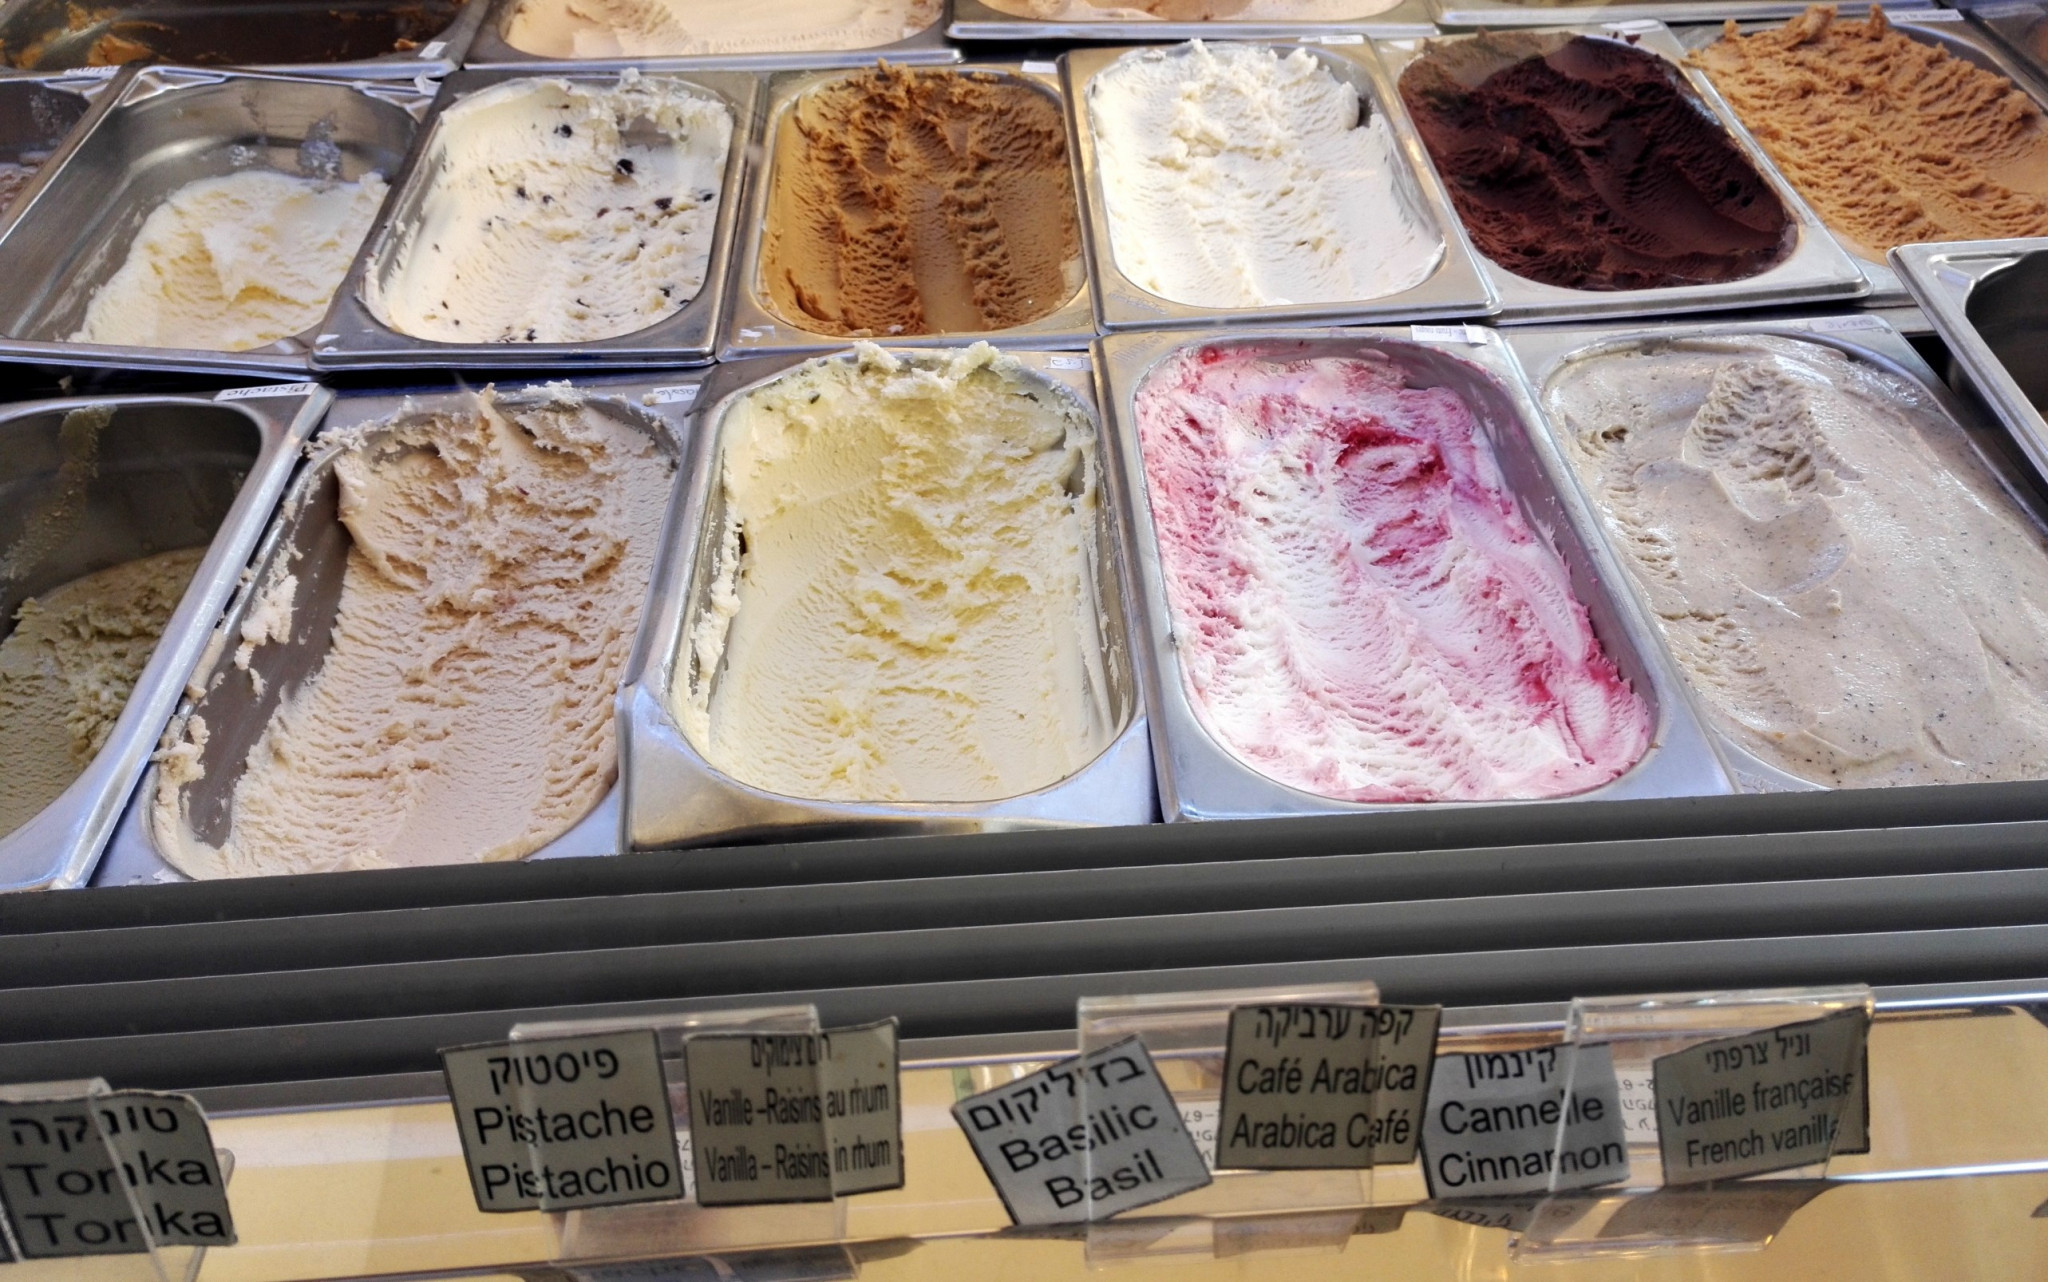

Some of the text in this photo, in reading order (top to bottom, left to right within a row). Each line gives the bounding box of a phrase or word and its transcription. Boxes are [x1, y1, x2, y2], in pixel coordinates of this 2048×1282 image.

[227, 384, 309, 396] Pistache
[1255, 1006, 1413, 1048] קפה ערביקה
[487, 1047, 619, 1096] פיסטוק
[1464, 1047, 1557, 1089] קינמון
[1705, 1029, 1811, 1074] וניל צרפתי
[1237, 1056, 1417, 1094] Café Arabica
[474, 1100, 655, 1145] Pistache
[700, 1088, 753, 1126] Vanille
[827, 1089, 845, 1118] au
[849, 1078, 889, 1116] rhum
[1439, 1088, 1604, 1135] Cannelle
[1668, 1087, 1746, 1127] Vanille
[9, 1106, 179, 1153] טונקה
[999, 1103, 1159, 1173] Basilic
[1230, 1112, 1336, 1148] Arabica
[1347, 1108, 1410, 1149] Café
[1687, 1129, 1764, 1168] French
[6, 1150, 213, 1196] Tonka
[481, 1154, 671, 1200] Pistachio
[704, 1145, 758, 1182] Vanilla
[776, 1143, 830, 1180] Raisins
[834, 1138, 848, 1172] in
[852, 1134, 891, 1172] rhum
[1045, 1147, 1165, 1209] Basil
[1438, 1141, 1624, 1188] Cinnamon
[25, 1202, 227, 1246] Tonka
